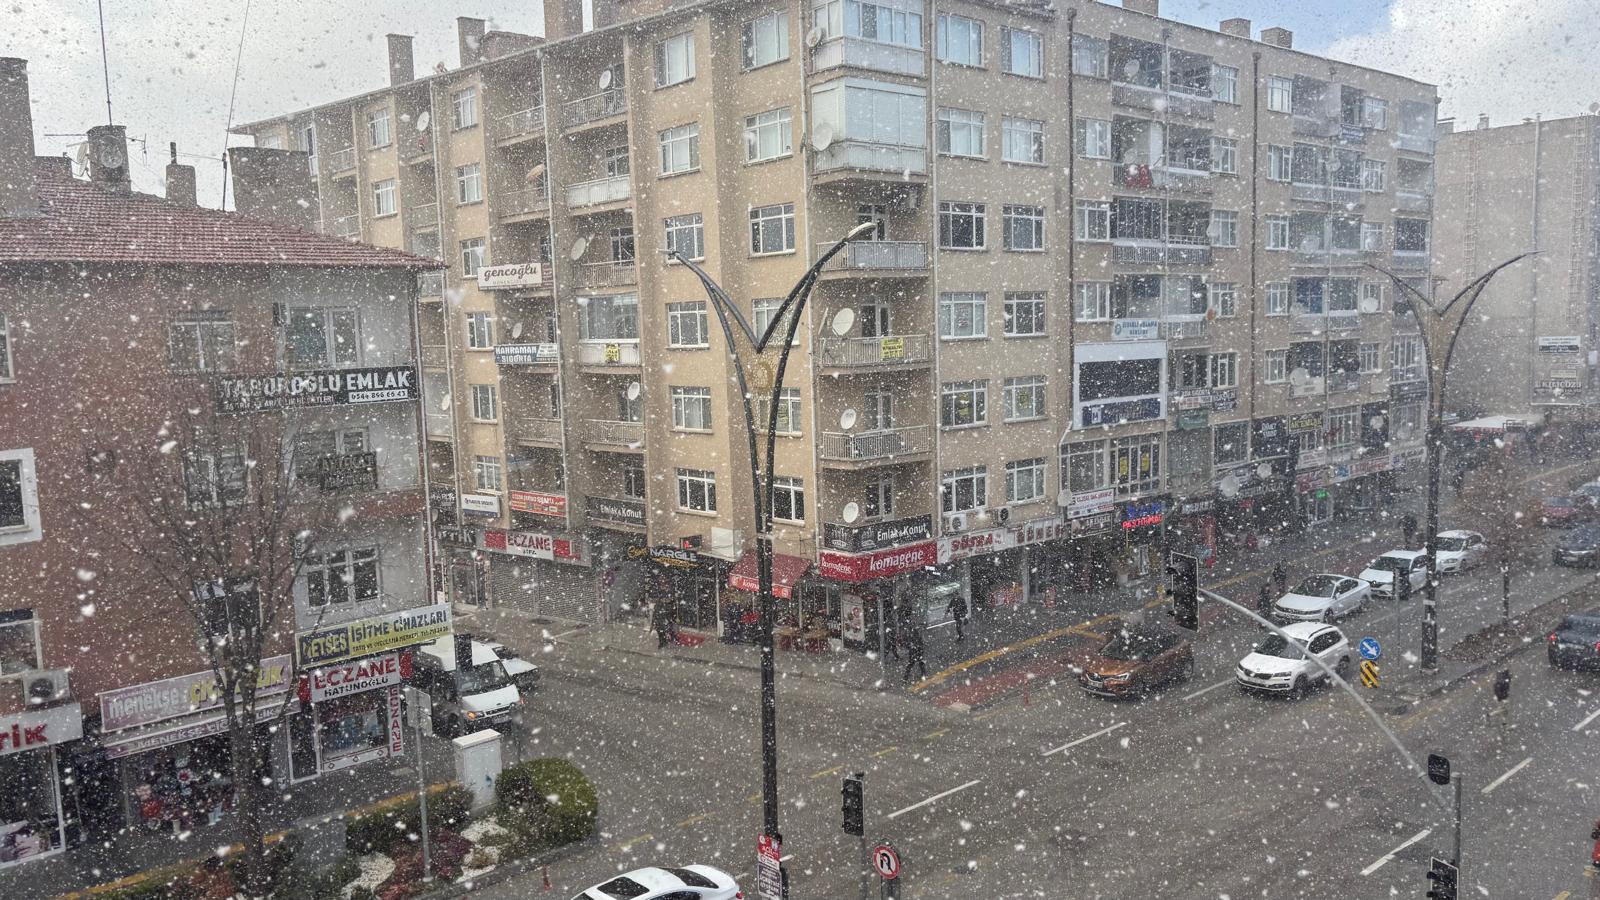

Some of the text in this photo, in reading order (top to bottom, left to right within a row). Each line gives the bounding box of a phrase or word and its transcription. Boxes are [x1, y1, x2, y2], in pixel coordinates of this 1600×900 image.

[346, 370, 411, 391] EMLAK
[621, 507, 642, 519] Konut
[903, 524, 927, 536] Konut
[507, 533, 552, 551] ECZANE
[870, 550, 924, 571] komagene
[315, 658, 396, 689] ECZANE
[390, 686, 402, 752] ECZANE
